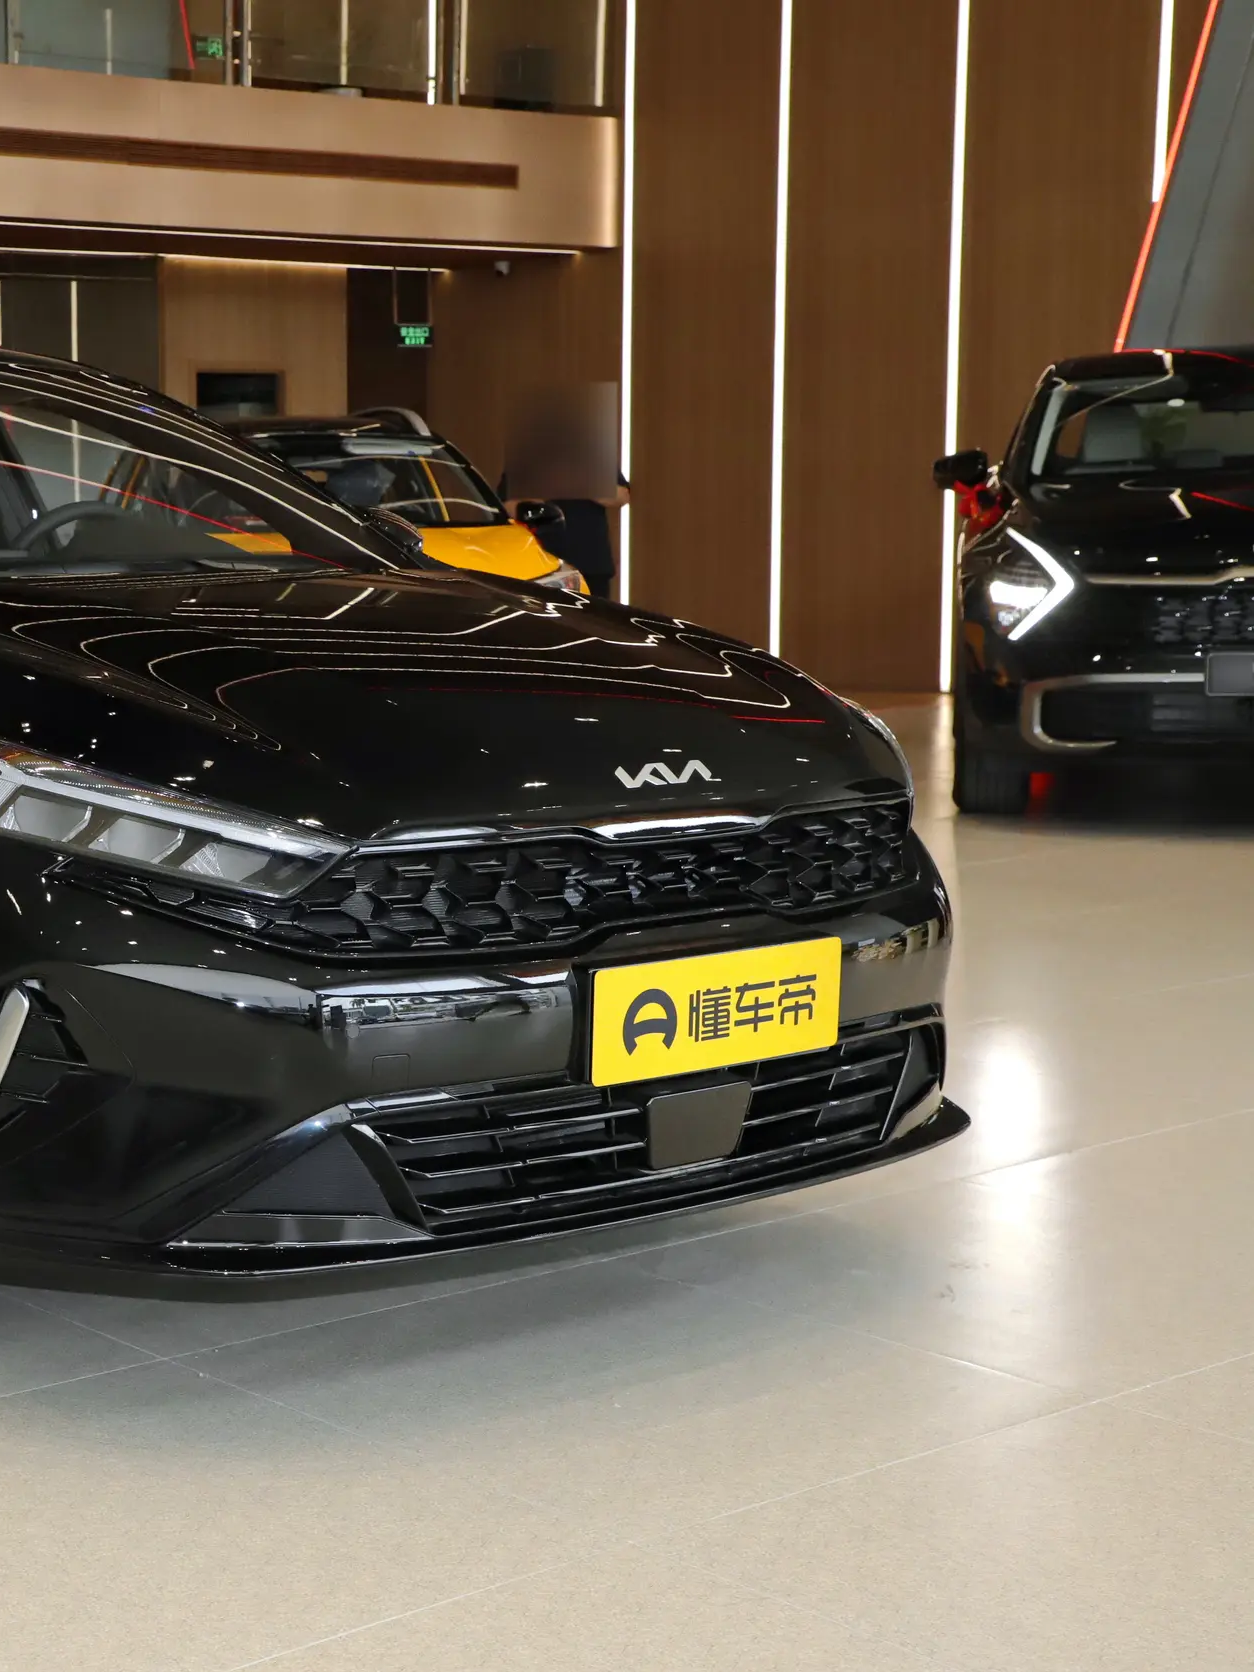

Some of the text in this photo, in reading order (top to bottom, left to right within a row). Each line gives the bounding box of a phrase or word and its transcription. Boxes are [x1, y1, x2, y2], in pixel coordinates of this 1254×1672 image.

[614, 760, 712, 788] KIA
[689, 974, 816, 1042] 懂车帝
